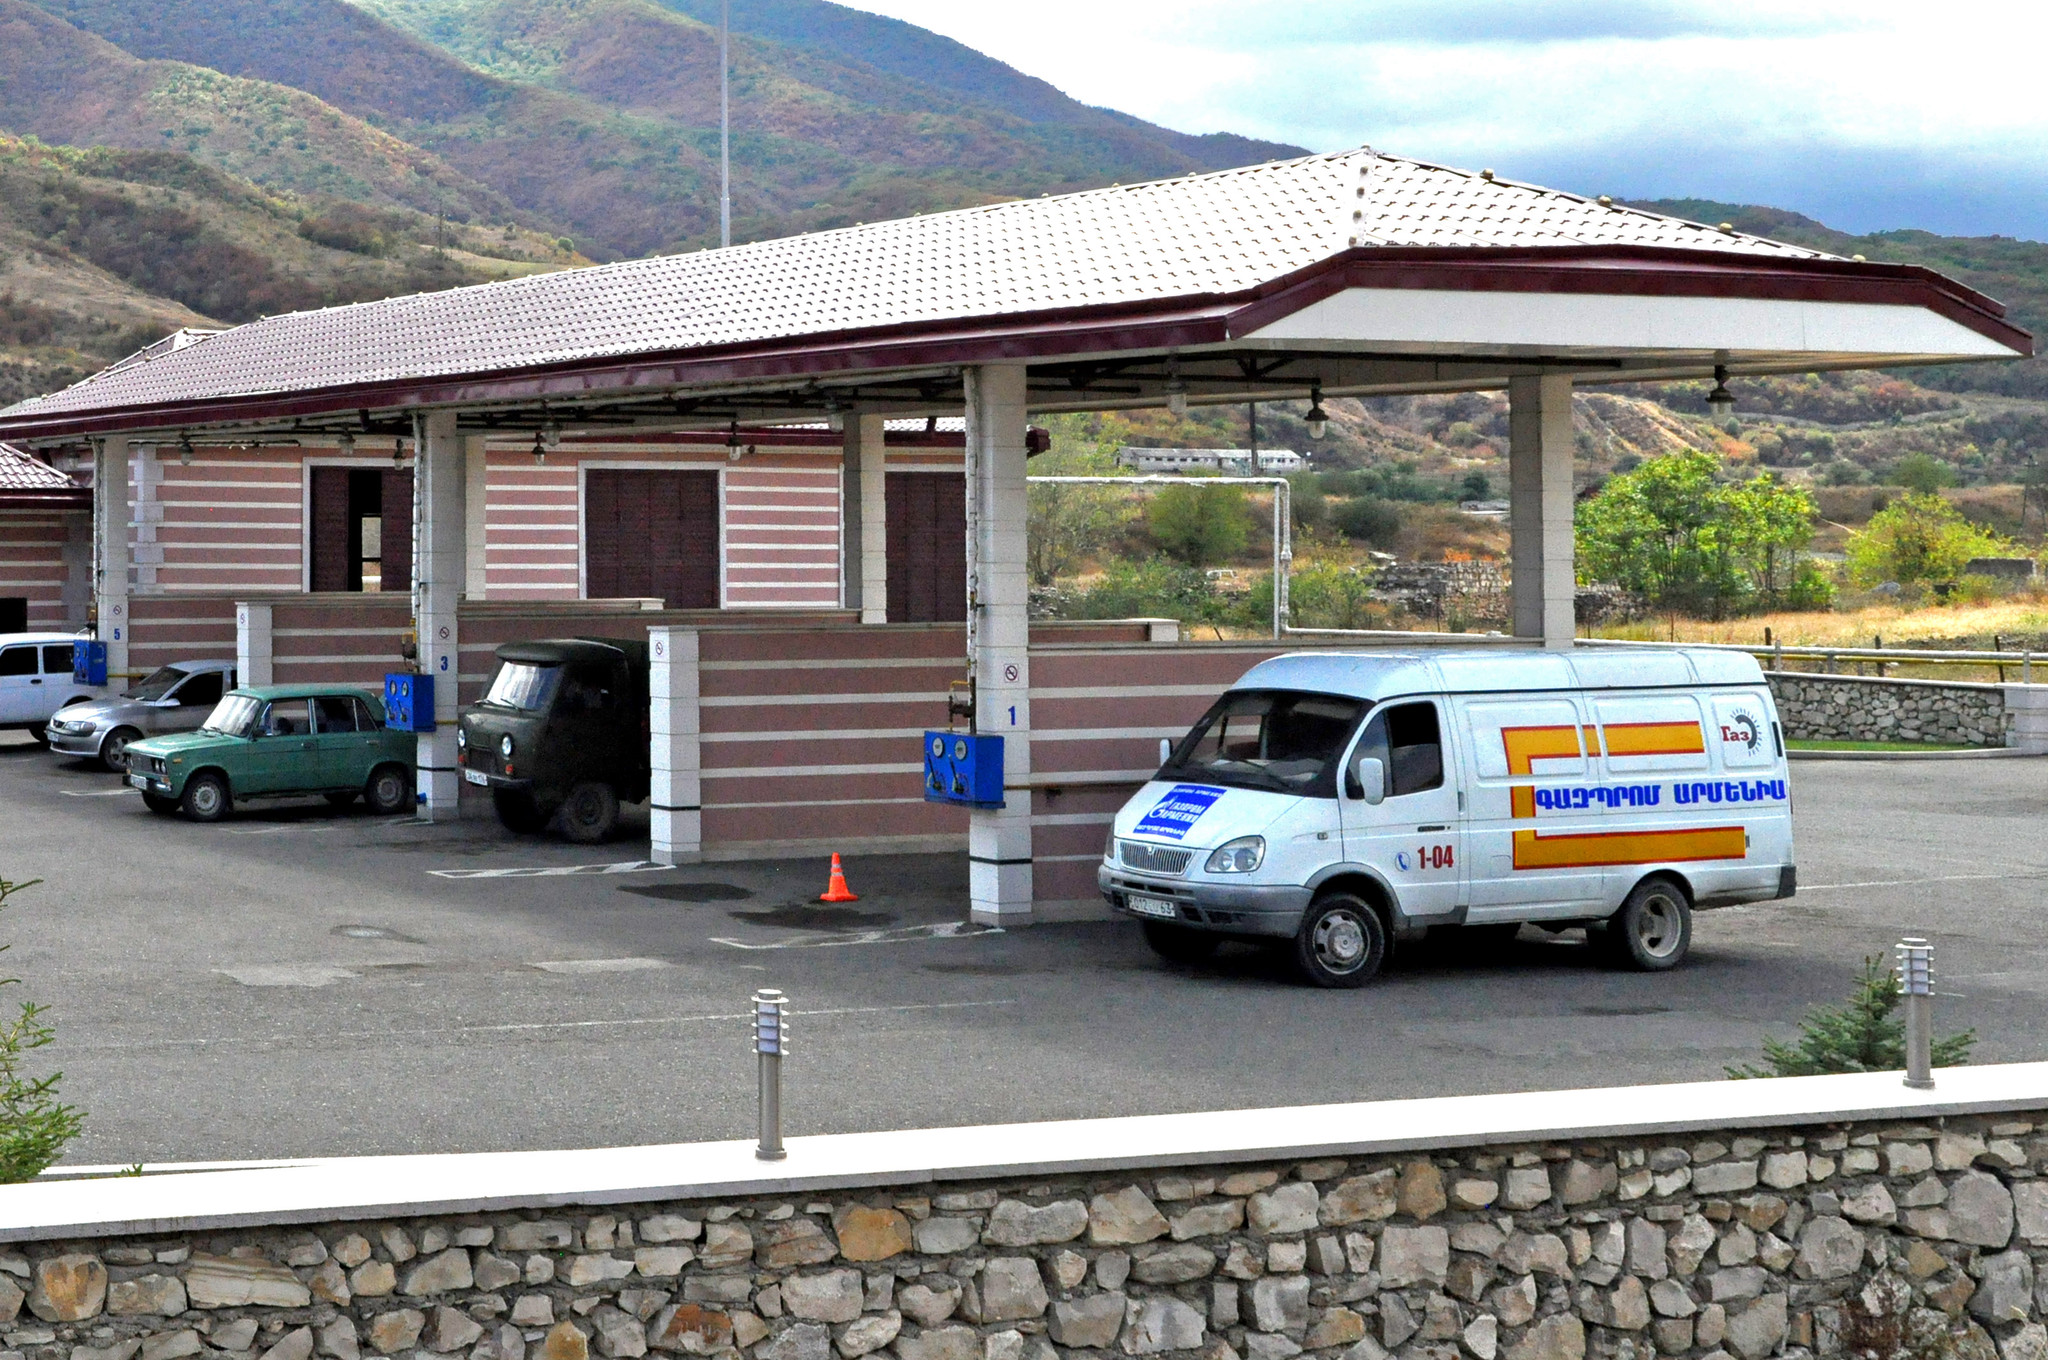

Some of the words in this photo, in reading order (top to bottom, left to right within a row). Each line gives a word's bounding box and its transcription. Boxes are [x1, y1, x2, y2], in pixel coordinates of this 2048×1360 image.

[114, 628, 121, 641] 5
[440, 655, 449, 671] 3
[1008, 705, 1016, 726] 1
[1535, 784, 1661, 810] ԳԱԶՊՐՈՄ
[1673, 779, 1787, 804] ԱՐՄԵՆԻԱ
[1417, 845, 1454, 869] 1-04
